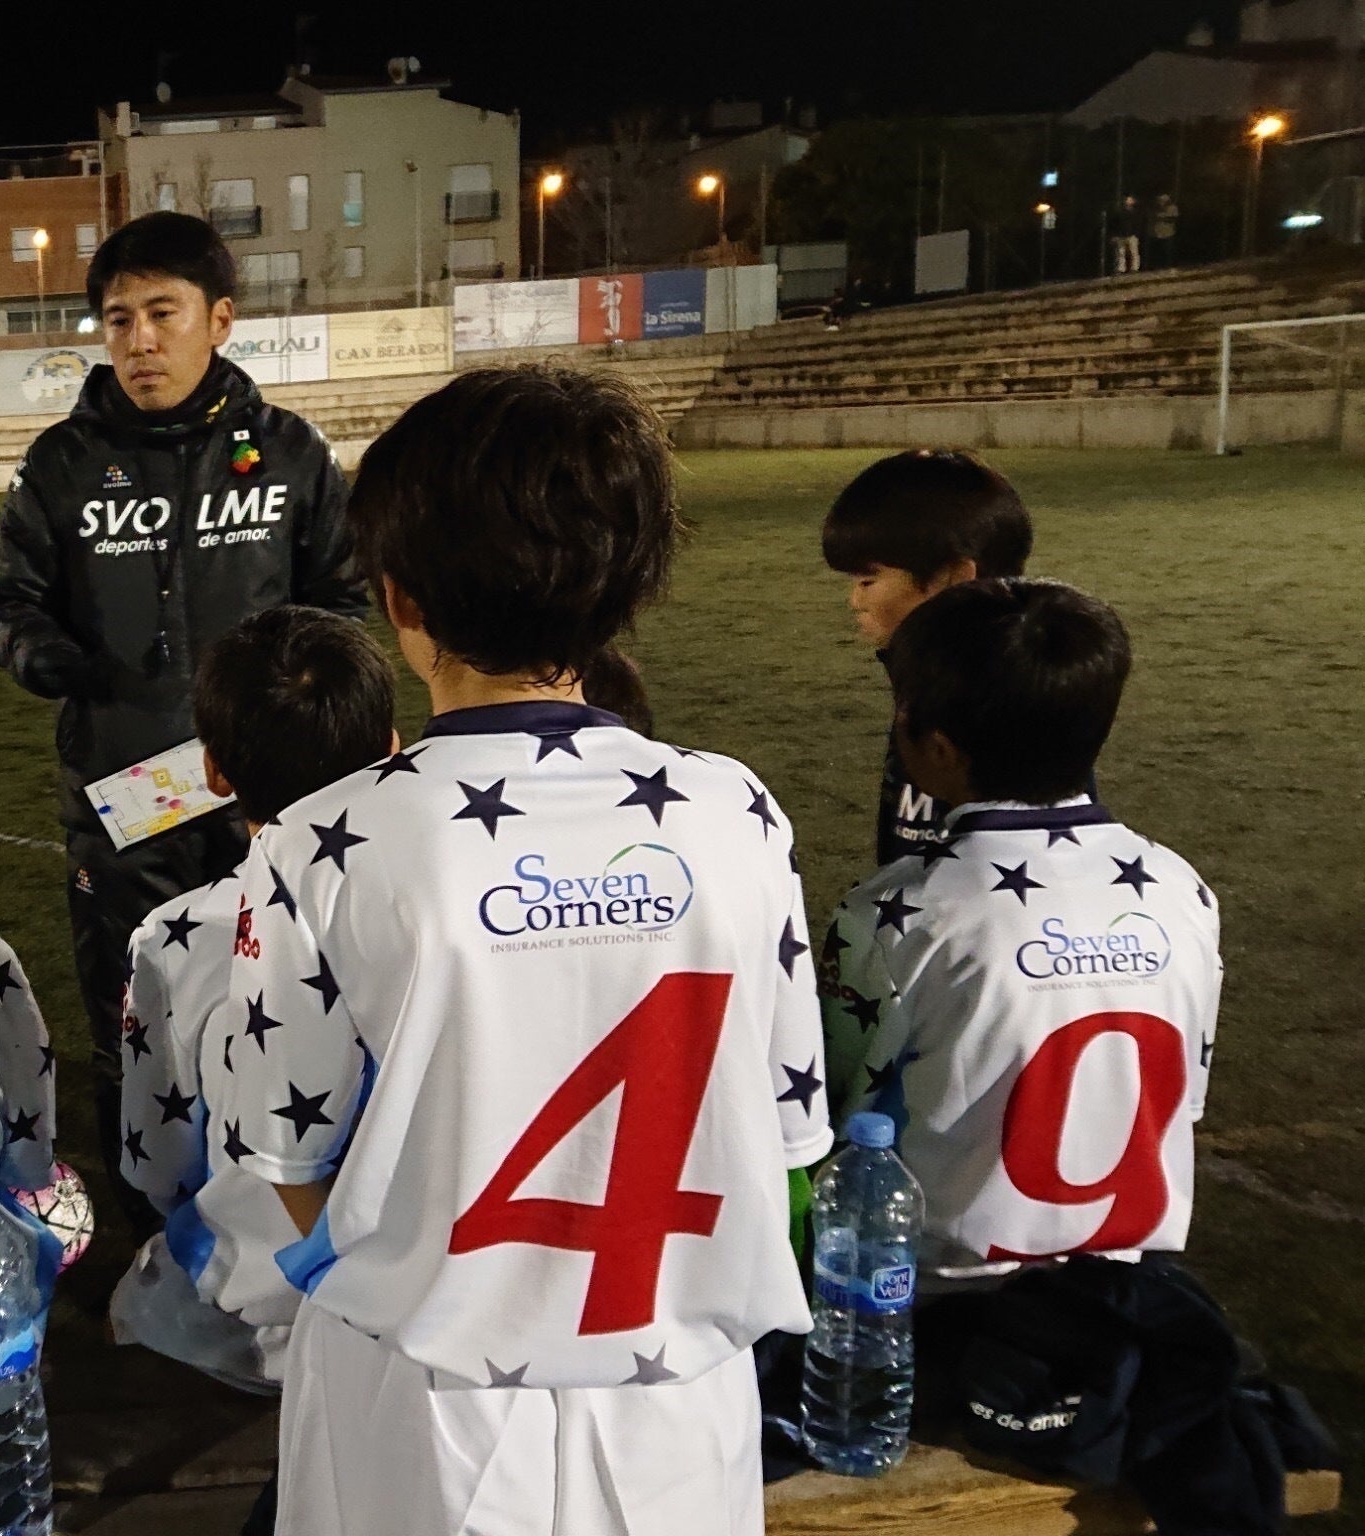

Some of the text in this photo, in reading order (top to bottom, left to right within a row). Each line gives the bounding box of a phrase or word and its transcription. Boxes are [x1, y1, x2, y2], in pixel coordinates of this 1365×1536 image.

[660, 310, 701, 325] Sirena
[198, 528, 271, 548] de amor.
[514, 854, 651, 905] Seven
[479, 885, 675, 936] Corners
[490, 932, 676, 954] INSURANCE SOLUTIONS INC.
[1041, 917, 1141, 956] Seven
[1016, 940, 1160, 979] Corners
[447, 971, 734, 1336] 4
[986, 1011, 1187, 1263] 9
[996, 1414, 1024, 1431] de
